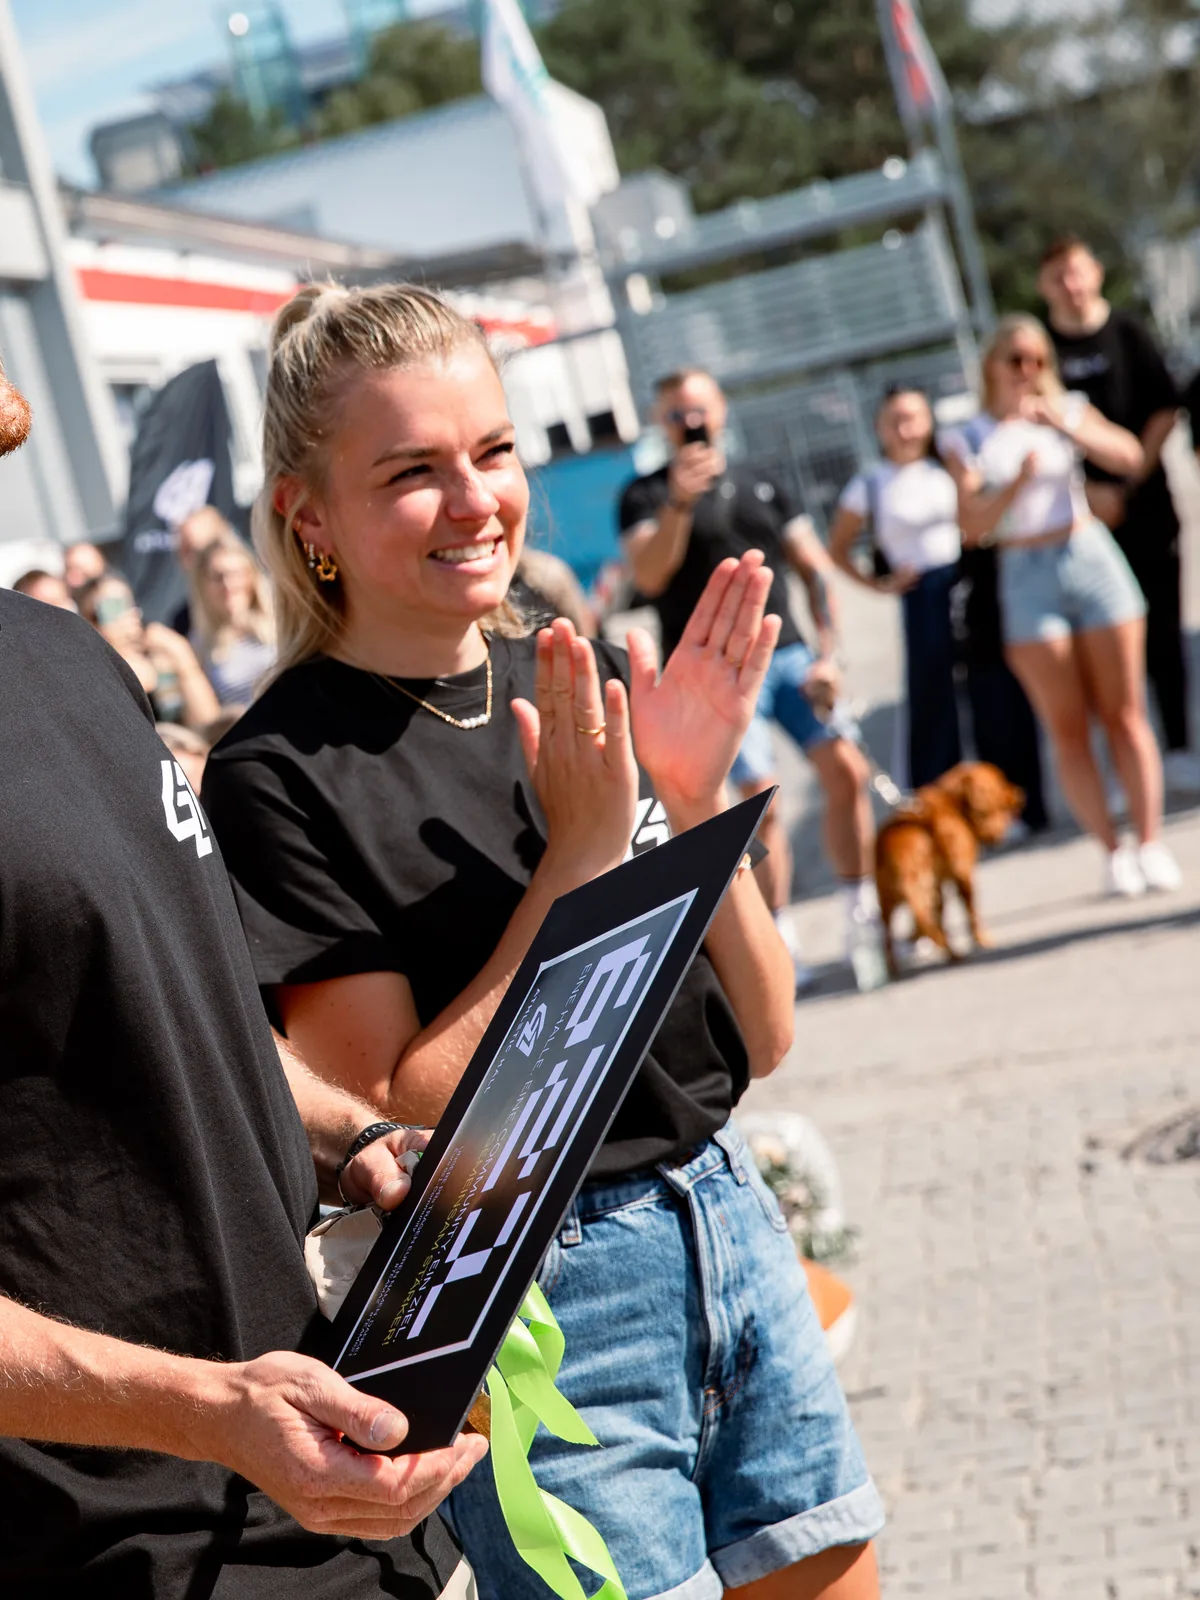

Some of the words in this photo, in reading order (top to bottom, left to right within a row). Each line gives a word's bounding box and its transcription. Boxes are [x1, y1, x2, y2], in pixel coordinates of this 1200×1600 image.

[564, 962, 592, 1006] EINE
[503, 986, 542, 1054] ATHLETIC
[529, 1009, 569, 1075] HALLE.
[482, 1057, 505, 1094] HALL
[504, 1079, 533, 1123] EINE
[430, 1131, 497, 1250] GEMEINSAM
[437, 1127, 508, 1254] COMMUNITY.
[408, 1204, 433, 1244] TRAGEN
[418, 1258, 440, 1291] EIN
[380, 1254, 434, 1346] STÄRKER!
[391, 1295, 421, 1342] ZIEL.
